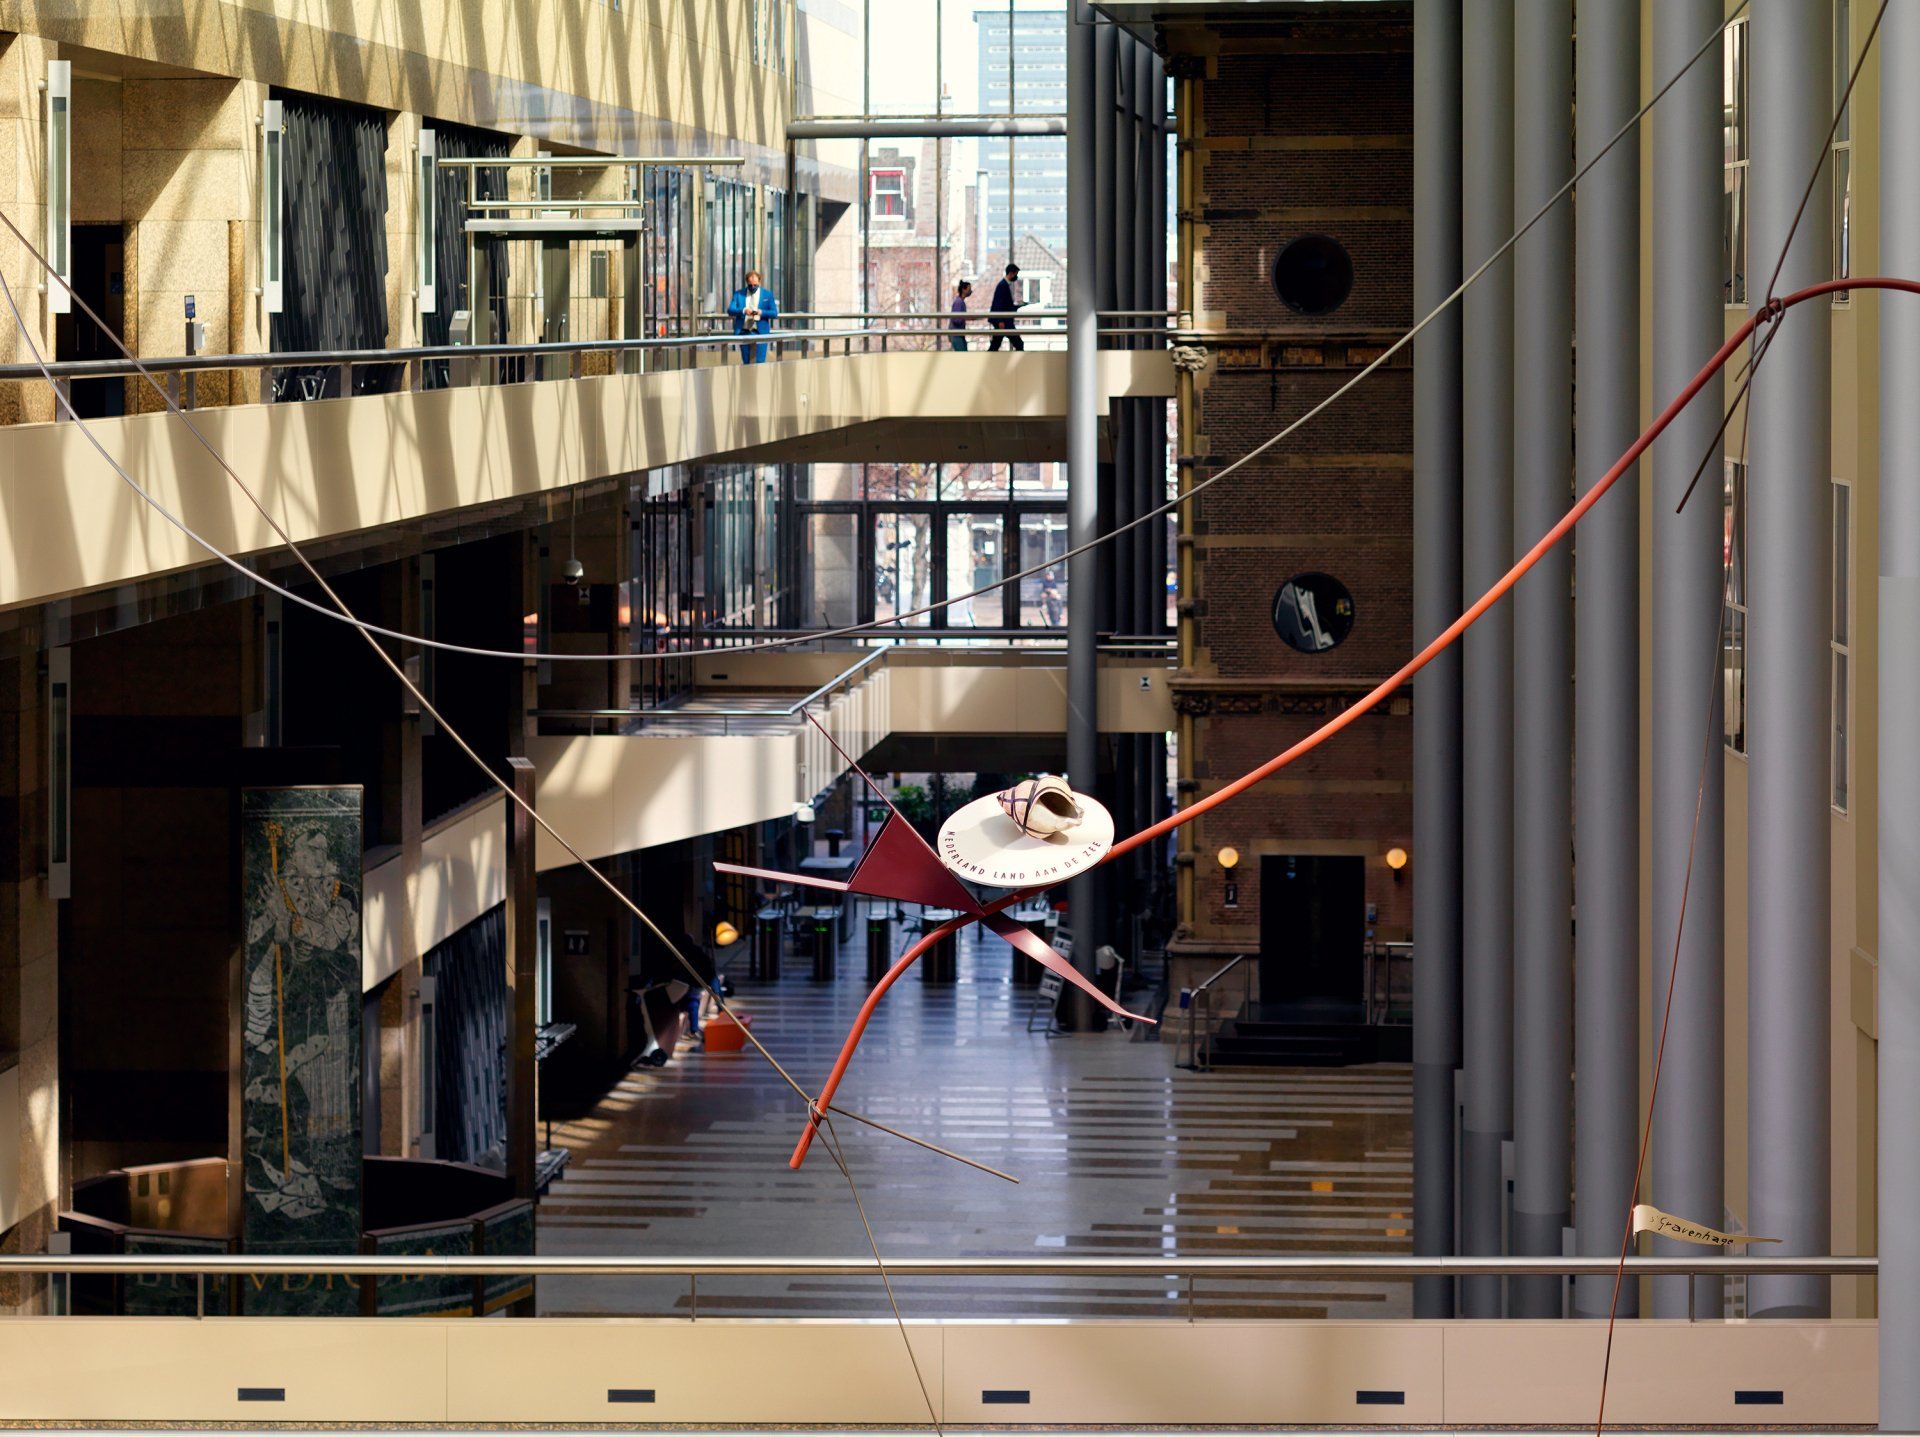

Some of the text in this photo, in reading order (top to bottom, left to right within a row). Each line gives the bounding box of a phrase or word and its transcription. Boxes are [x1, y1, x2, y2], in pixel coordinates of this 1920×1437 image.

[945, 831, 1101, 880] NEDERLAND LAND AAN DE ZEE
